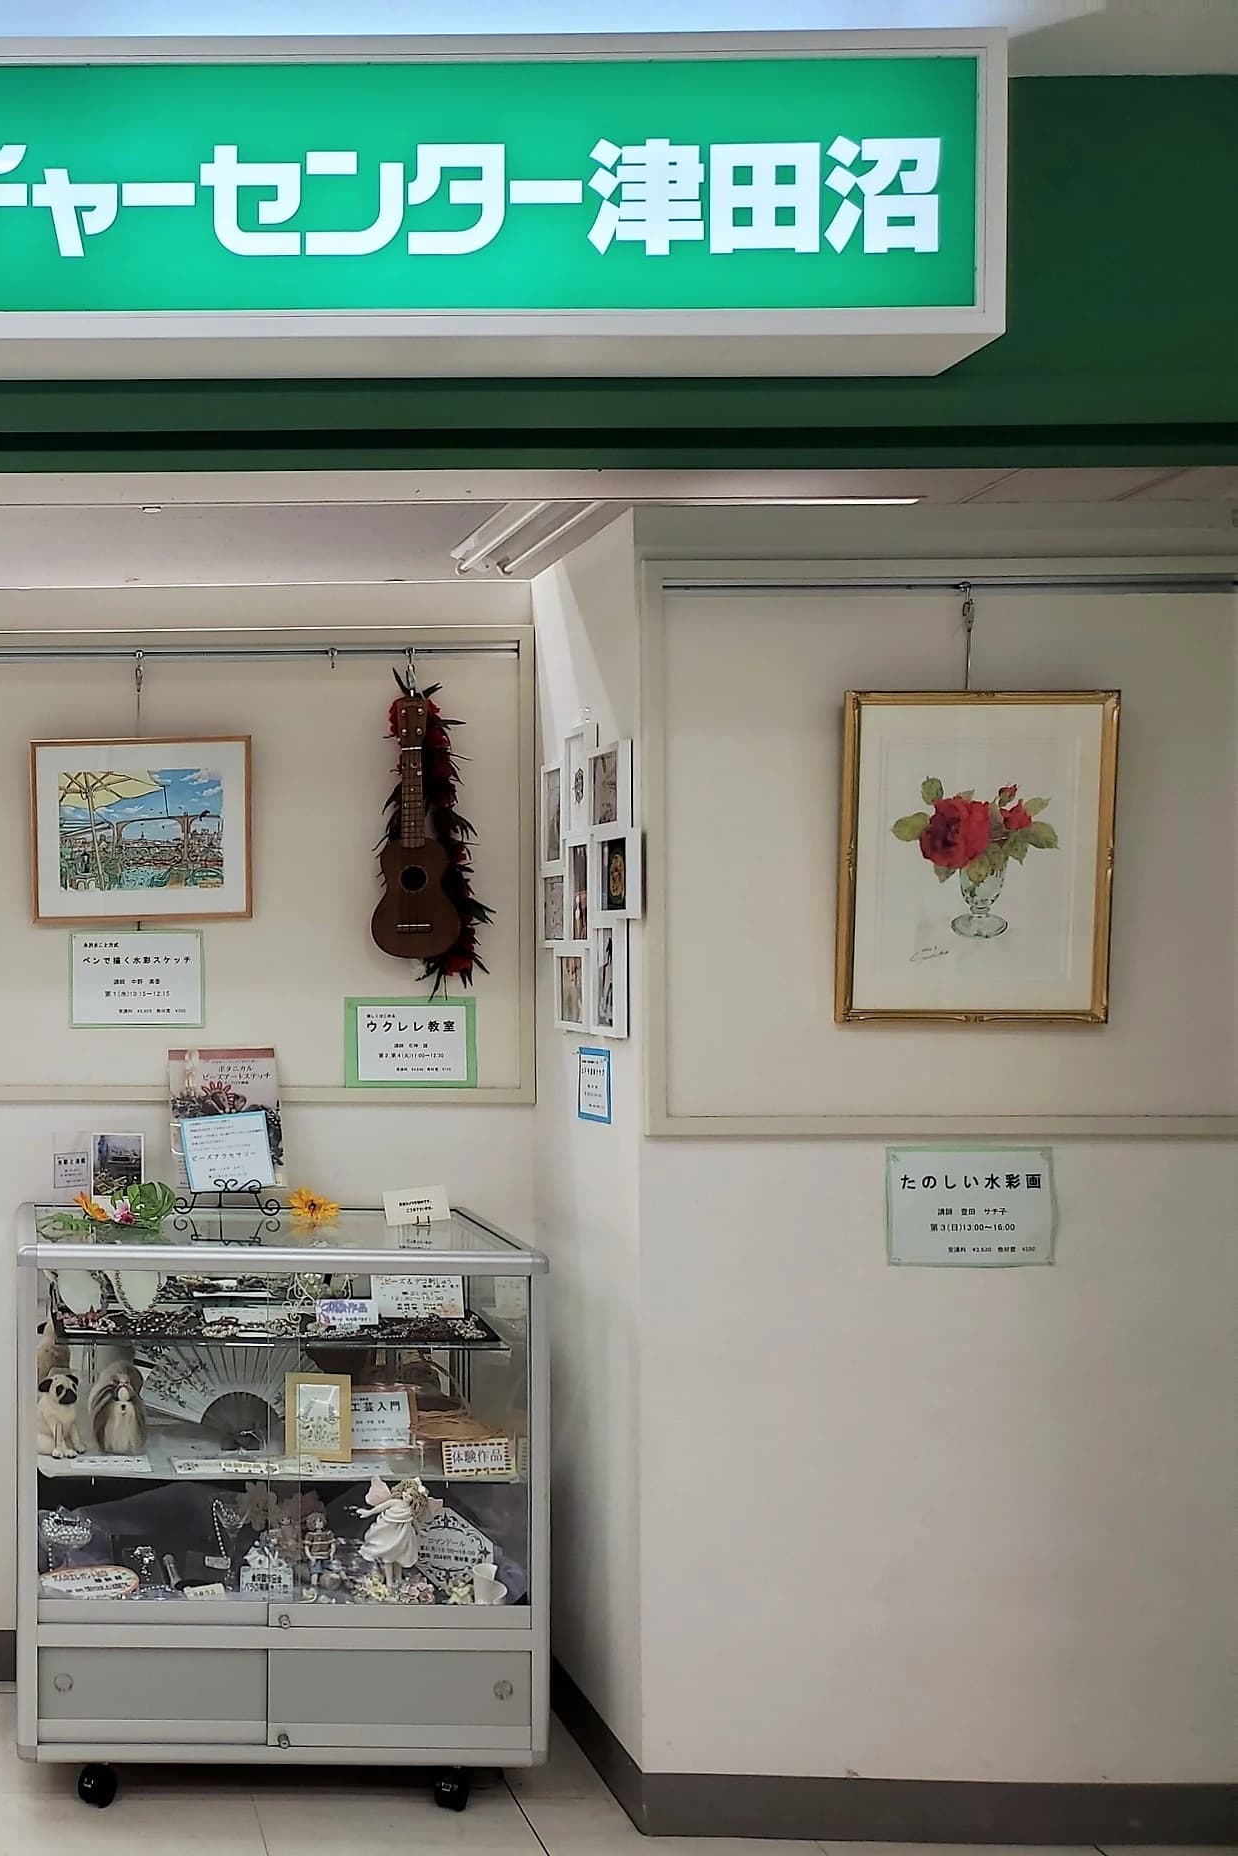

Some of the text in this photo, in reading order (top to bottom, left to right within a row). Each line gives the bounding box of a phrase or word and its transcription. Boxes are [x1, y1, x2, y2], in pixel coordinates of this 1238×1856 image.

[82, 956, 191, 965] ペンで描く水彩スケッチ
[366, 1020, 456, 1032] ウクレレ教室
[900, 1173, 1042, 1190] たのしい水彩画
[938, 1208, 953, 1216] 講師
[351, 1401, 401, 1412] 工芸入門
[452, 1449, 503, 1463] 体験作品
